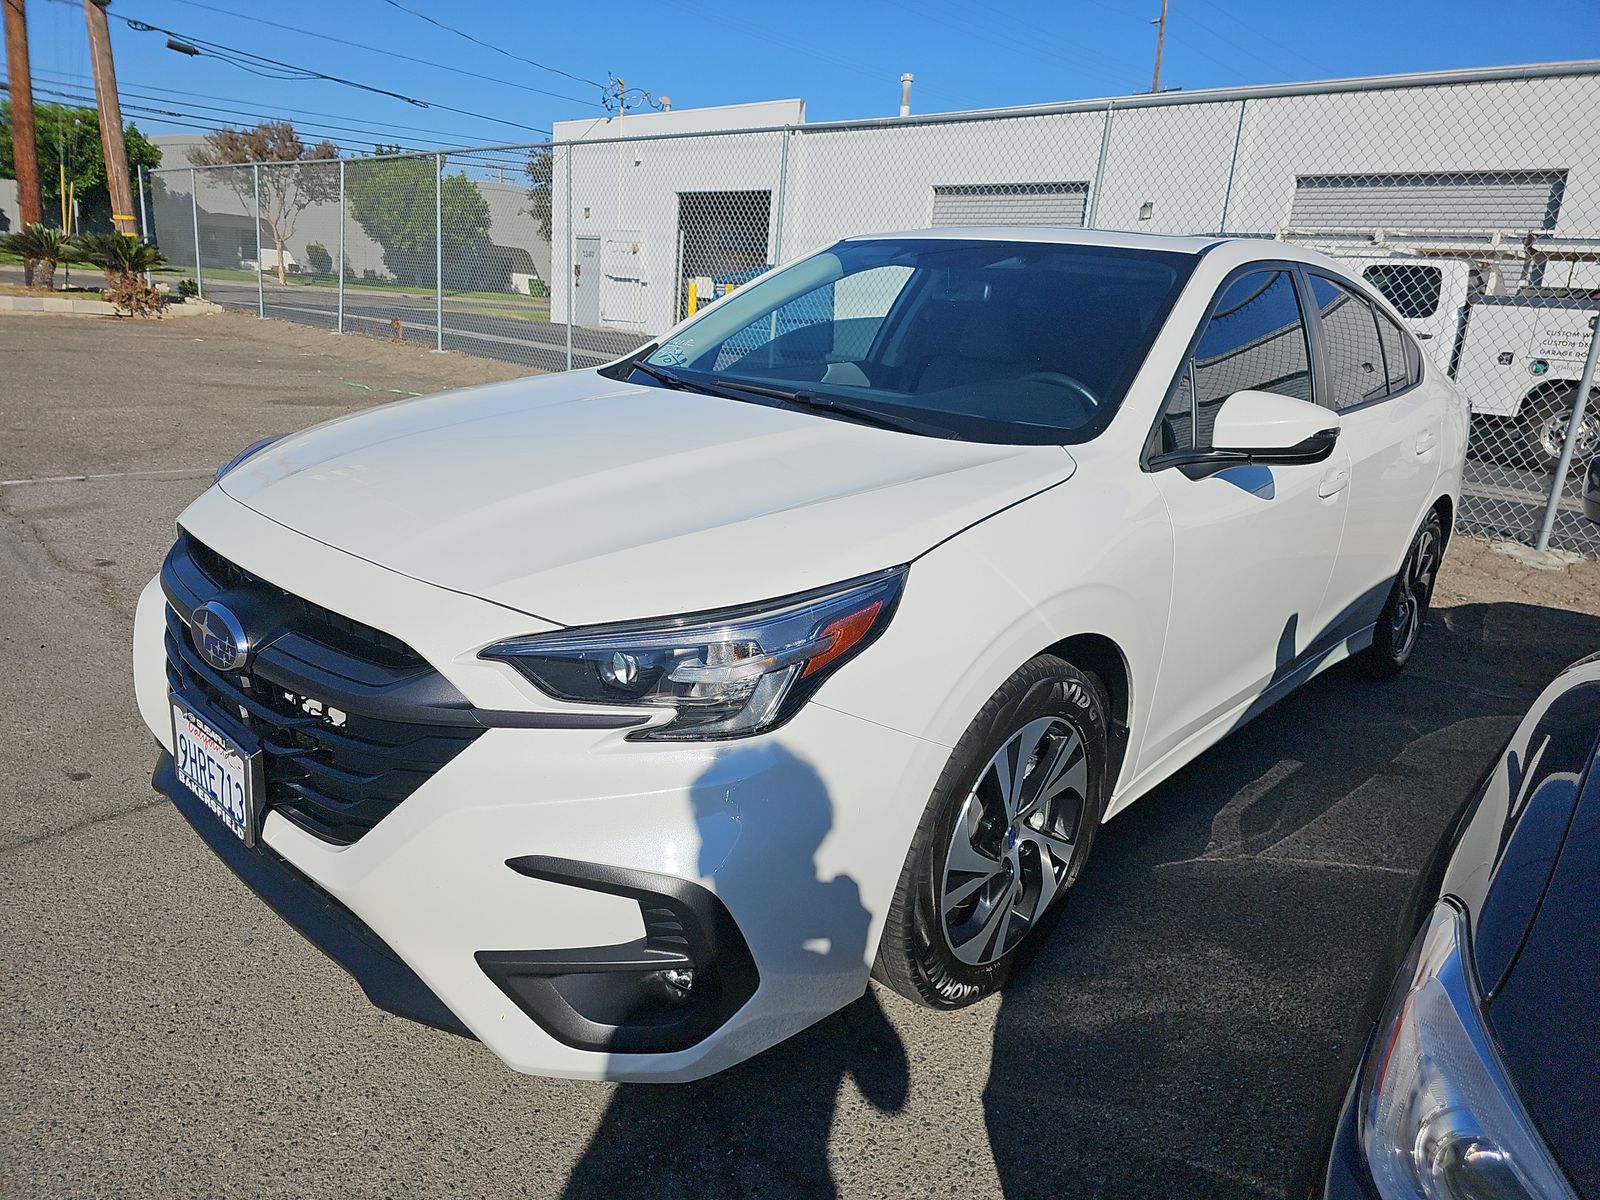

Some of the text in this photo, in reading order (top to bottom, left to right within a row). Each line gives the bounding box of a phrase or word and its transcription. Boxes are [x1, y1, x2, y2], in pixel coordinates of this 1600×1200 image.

[1546, 330, 1580, 338] CUSTOM
[1542, 340, 1576, 348] CUSTOM
[1539, 349, 1573, 357] GARAGE
[180, 733, 245, 825] 9HRE713
[179, 772, 245, 841] BAKERSFIELD
